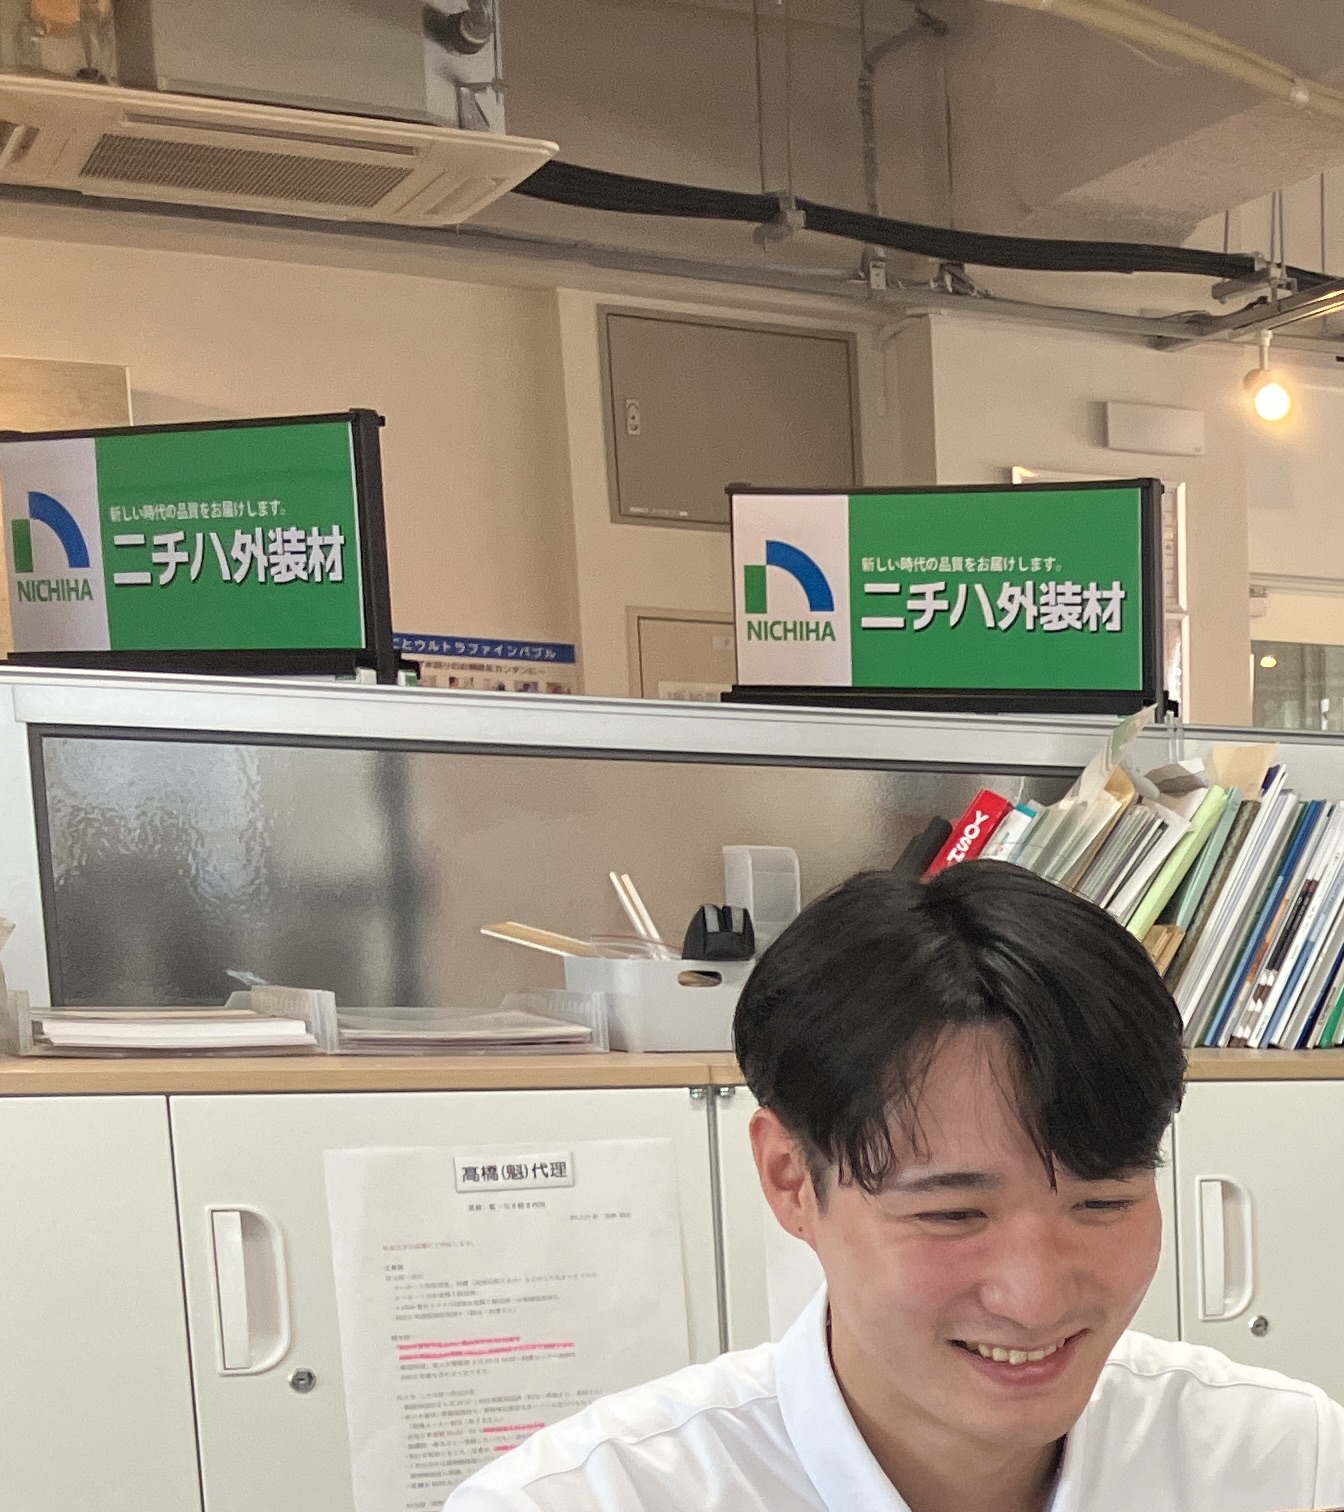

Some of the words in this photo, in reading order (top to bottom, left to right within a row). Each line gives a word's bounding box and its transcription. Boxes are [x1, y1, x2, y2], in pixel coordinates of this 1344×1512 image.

[113, 525, 345, 586] ニチハ外装材
[861, 556, 1063, 574] 新しい時代の品質をお届けします。
[17, 579, 94, 603] NICHIHA
[861, 580, 1126, 633] ニチハ外装材
[747, 620, 836, 642] NICHIHA
